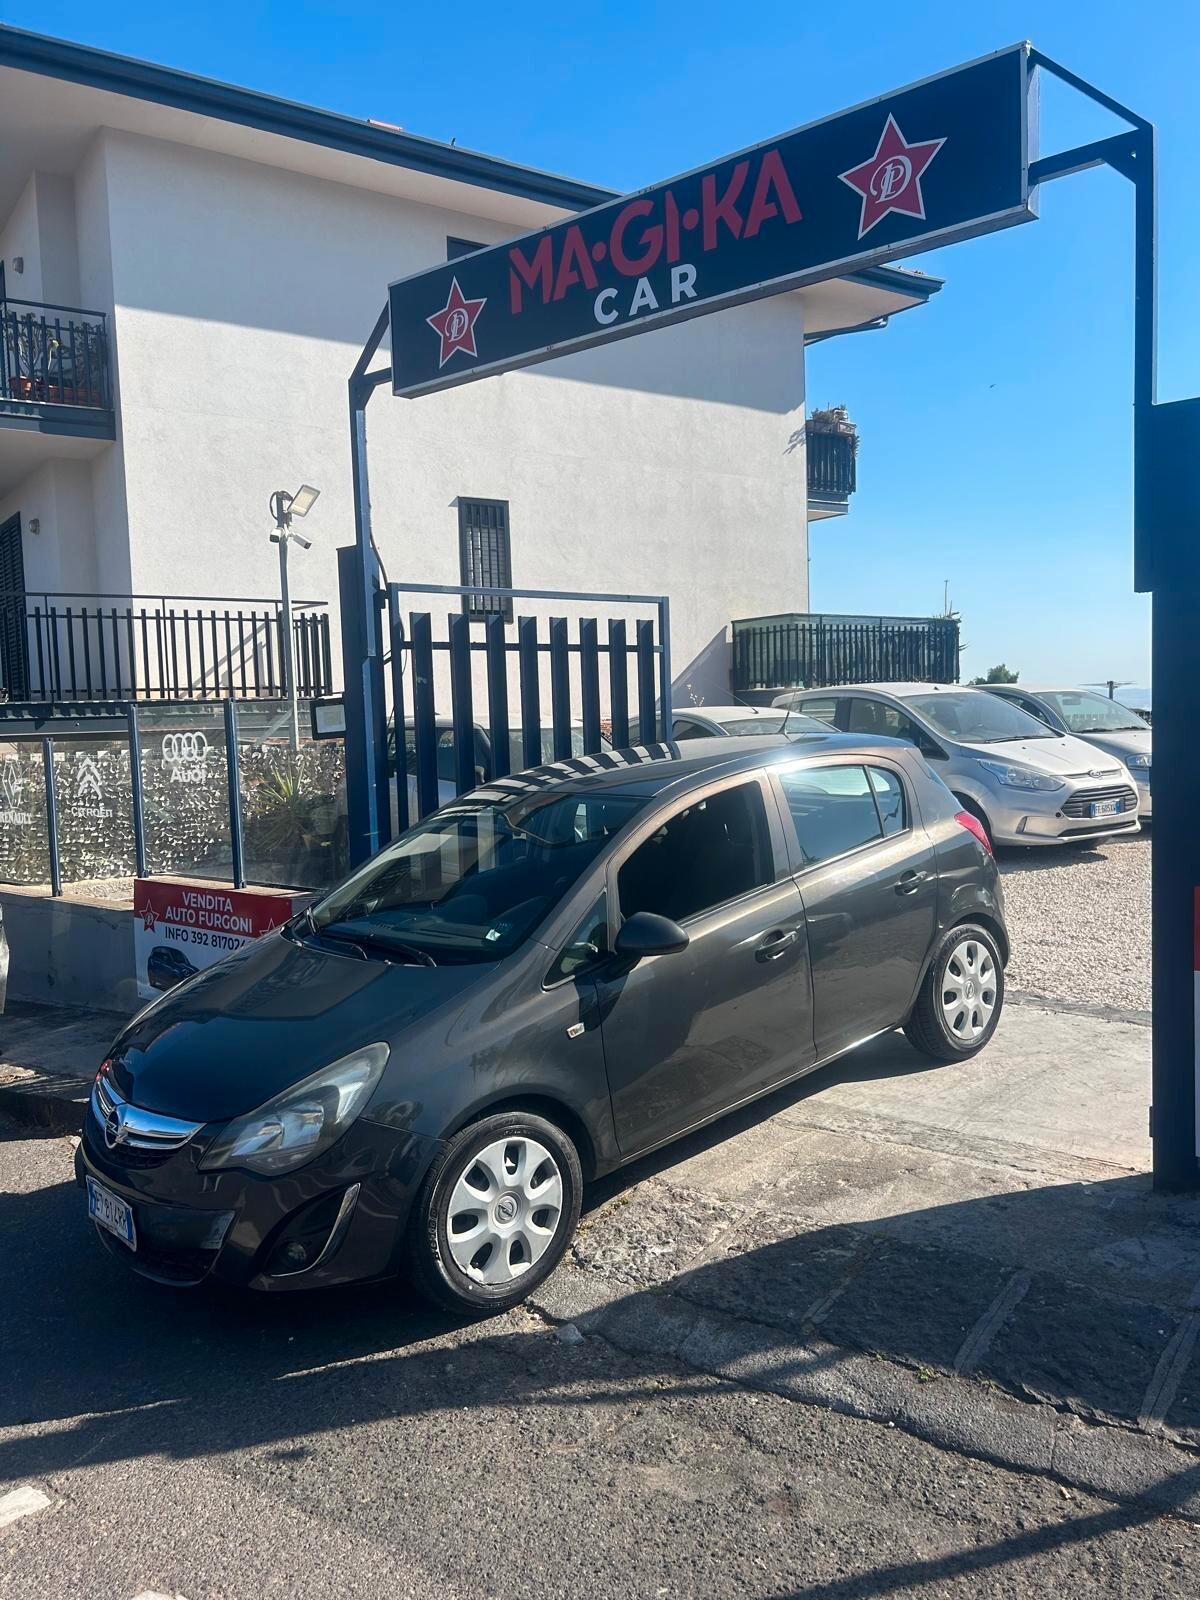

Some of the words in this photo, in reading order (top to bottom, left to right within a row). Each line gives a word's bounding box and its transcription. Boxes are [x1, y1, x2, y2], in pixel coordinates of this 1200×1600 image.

[593, 263, 698, 325] CAR
[182, 891, 234, 913] VENDITA
[165, 906, 196, 924] AUTO
[198, 911, 253, 934] FURGONI
[165, 926, 189, 942] INFO
[190, 930, 209, 946] 392
